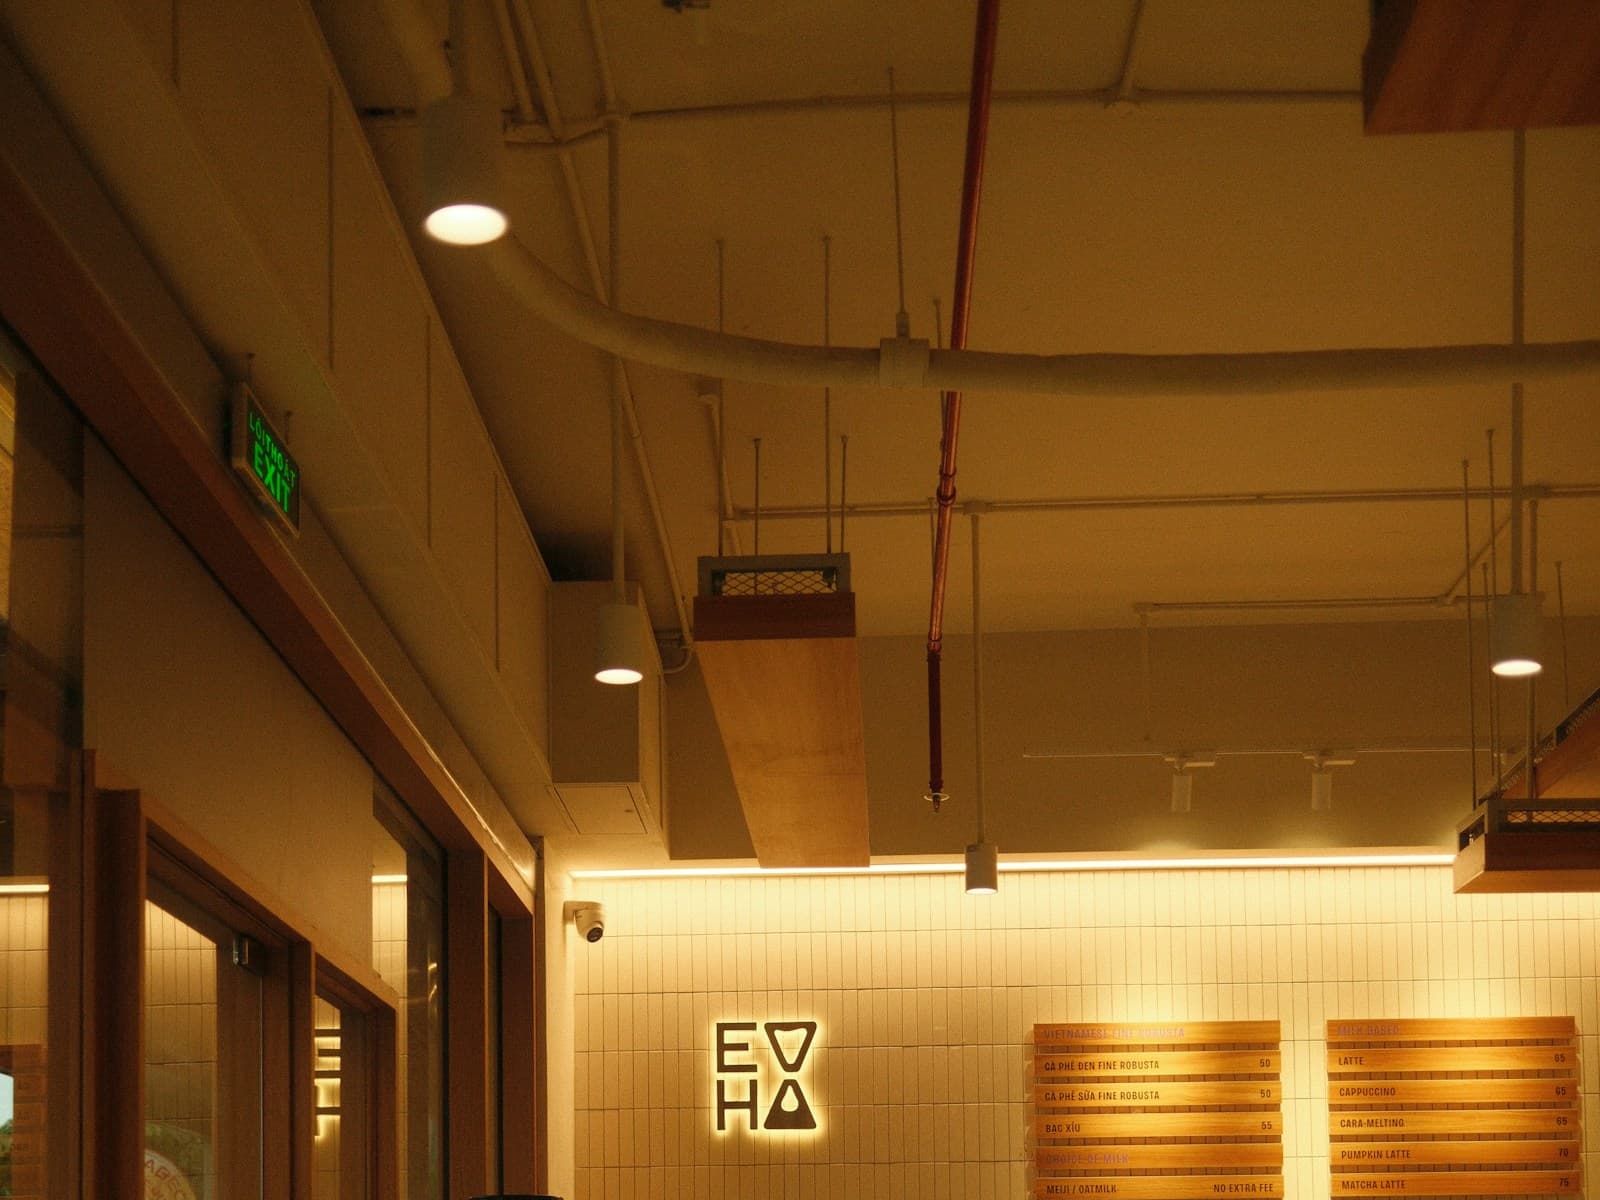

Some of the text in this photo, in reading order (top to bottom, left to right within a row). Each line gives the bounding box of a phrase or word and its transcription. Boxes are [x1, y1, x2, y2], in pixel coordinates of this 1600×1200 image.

[254, 440, 292, 513] EXIT
[1045, 1027, 1185, 1040] VIETNAMESE FINE ROBUSTA
[1368, 1024, 1399, 1035] BASED
[1098, 1061, 1117, 1070] FINE
[1120, 1060, 1160, 1070] ROBUSTA
[1259, 1058, 1271, 1068] 50
[1338, 1056, 1364, 1066] LATTE
[1098, 1091, 1117, 1100] FINE
[1120, 1090, 1160, 1100] ROBUSTA
[1260, 1089, 1271, 1098] 50
[1339, 1087, 1396, 1097] CAPPUCCINO
[1261, 1121, 1272, 1130] 55
[1340, 1118, 1404, 1128] CARA-MELTING
[1556, 1117, 1568, 1126] 65
[1341, 1149, 1411, 1159] PUMPKIN LATTE
[1559, 1148, 1569, 1157] 70
[1088, 1153, 1098, 1163] OF
[1103, 1153, 1129, 1163] MILK
[1046, 1184, 1070, 1194] MEIJI
[1078, 1184, 1117, 1194] OATMILK
[1213, 1183, 1226, 1193] NO
[1229, 1183, 1256, 1193] EXTRA
[1259, 1182, 1274, 1192] FEE
[1342, 1180, 1405, 1190] MATCHA LATTE
